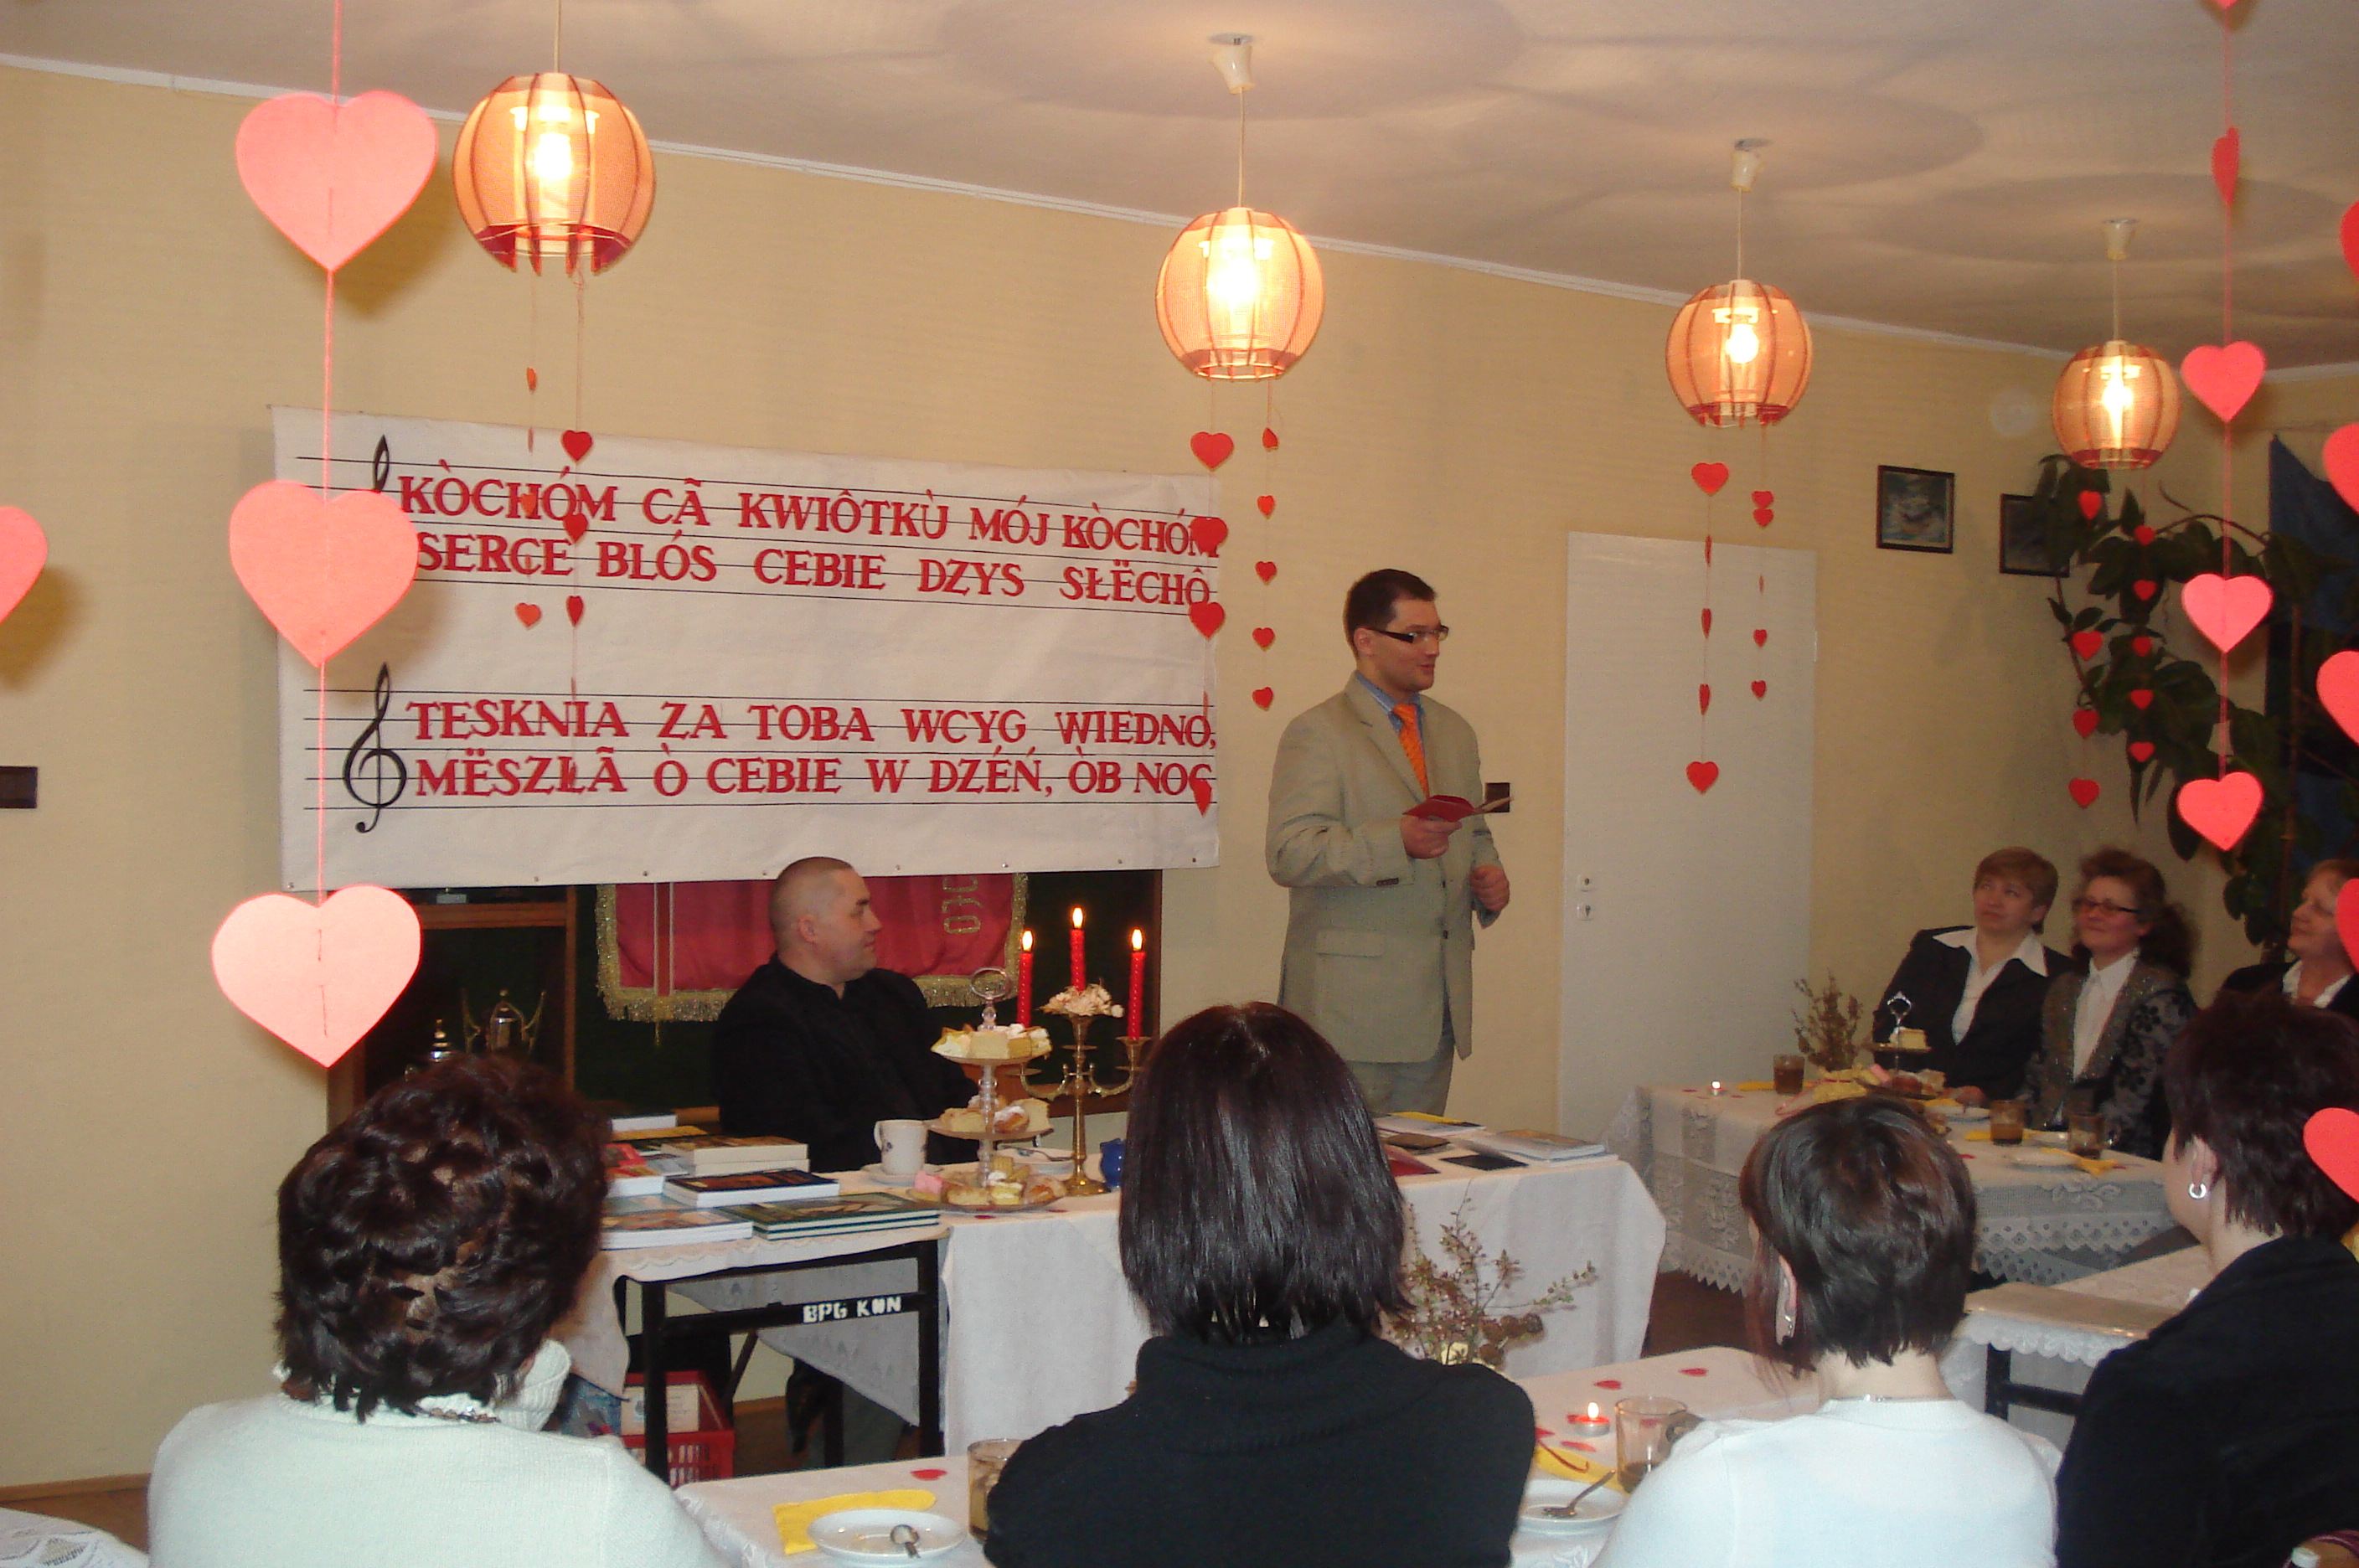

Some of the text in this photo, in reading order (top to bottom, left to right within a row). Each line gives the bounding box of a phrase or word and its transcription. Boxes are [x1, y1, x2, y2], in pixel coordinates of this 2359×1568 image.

[968, 495, 1050, 546] MÓJ
[417, 531, 572, 575] SERCE
[596, 529, 717, 581] BLÓS
[753, 549, 886, 590] CEBIE
[917, 559, 1025, 596] DZYS
[405, 699, 1217, 750] TESKNIA ZA TOBA WCYG WIEDNO,
[653, 742, 689, 797] Ò
[706, 757, 842, 794] CEBIE
[865, 759, 911, 793] W
[1067, 745, 1123, 794] ÒB
